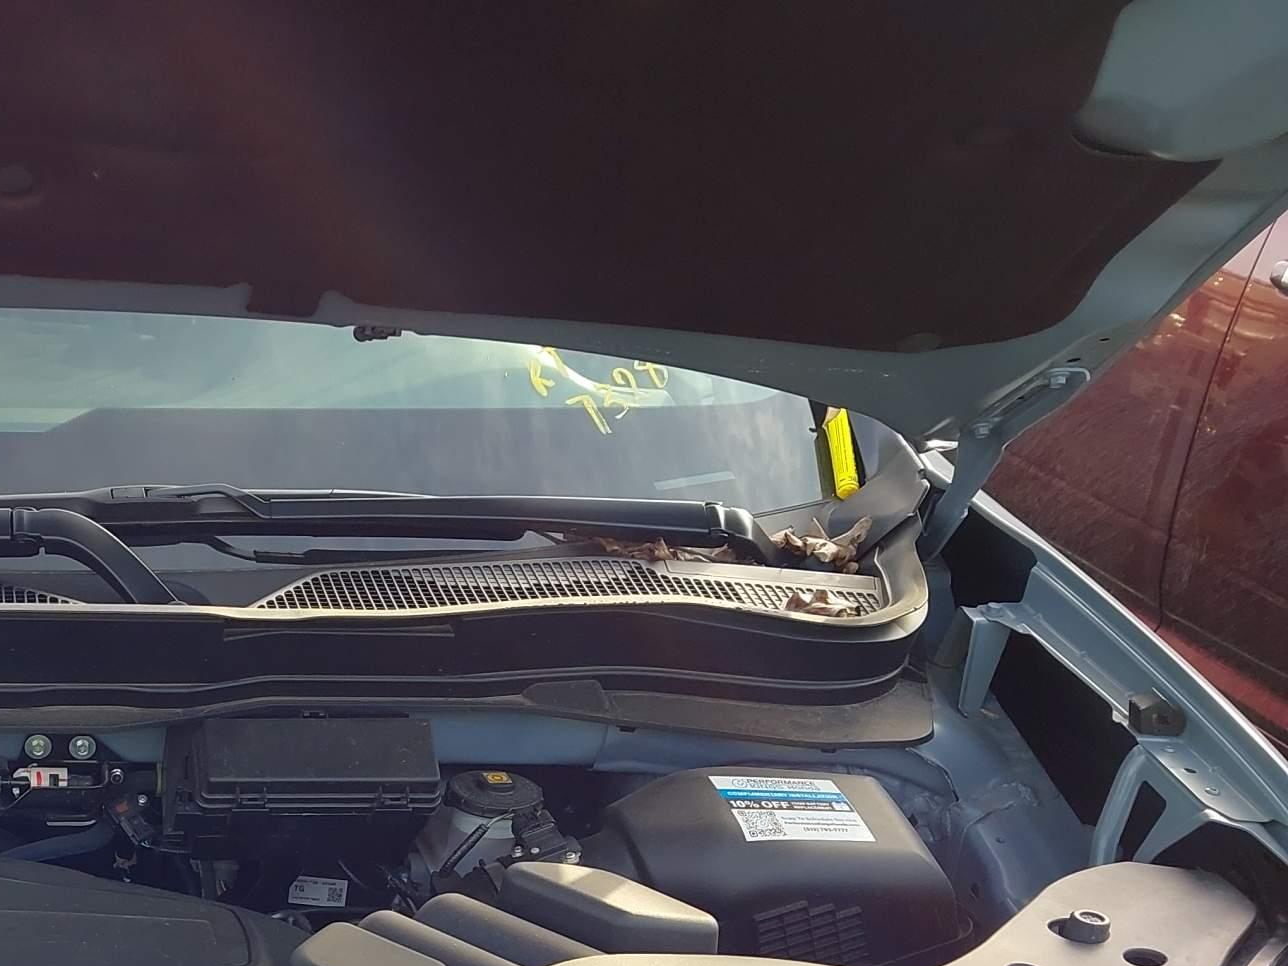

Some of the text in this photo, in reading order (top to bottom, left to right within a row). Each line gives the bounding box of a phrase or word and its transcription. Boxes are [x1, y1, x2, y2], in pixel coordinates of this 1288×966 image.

[747, 778, 816, 787] PERFORMANCE
[728, 800, 761, 809] 10%
[760, 800, 791, 809] OFF
